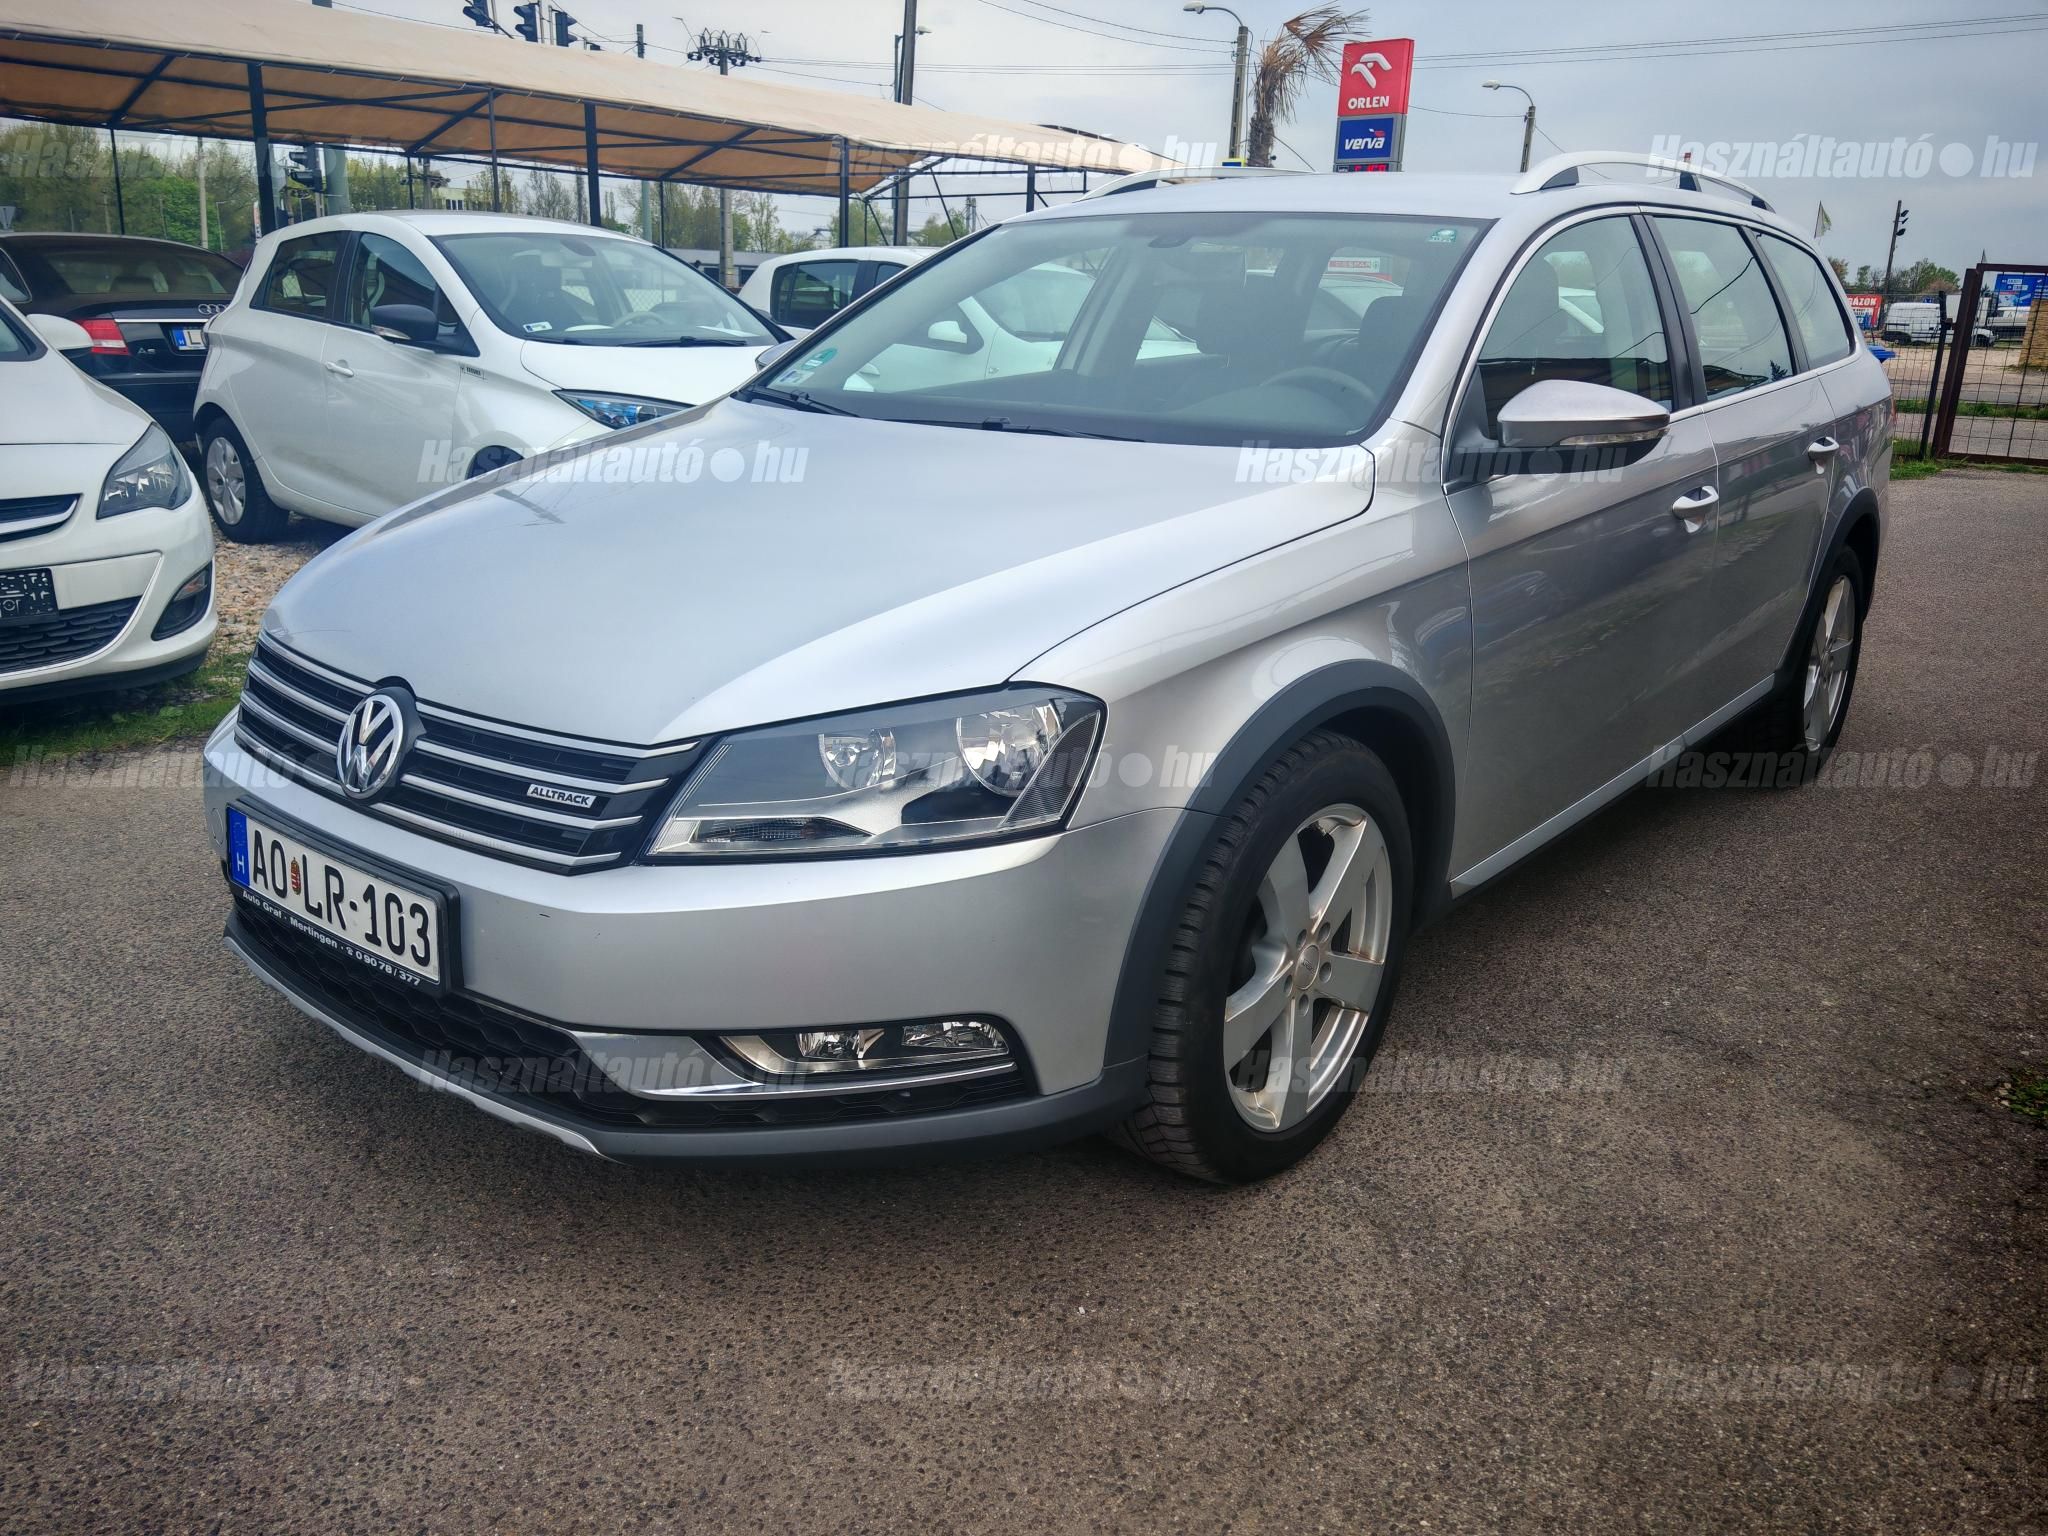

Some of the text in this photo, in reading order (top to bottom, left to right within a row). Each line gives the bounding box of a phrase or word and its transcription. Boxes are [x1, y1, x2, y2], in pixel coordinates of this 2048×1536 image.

[1347, 95, 1390, 110] ORLEN
[1344, 137, 1386, 151] verva
[530, 786, 591, 806] ALLTRACK
[236, 852, 245, 875] H
[242, 890, 261, 906] Auto
[290, 917, 338, 949] Mertingen
